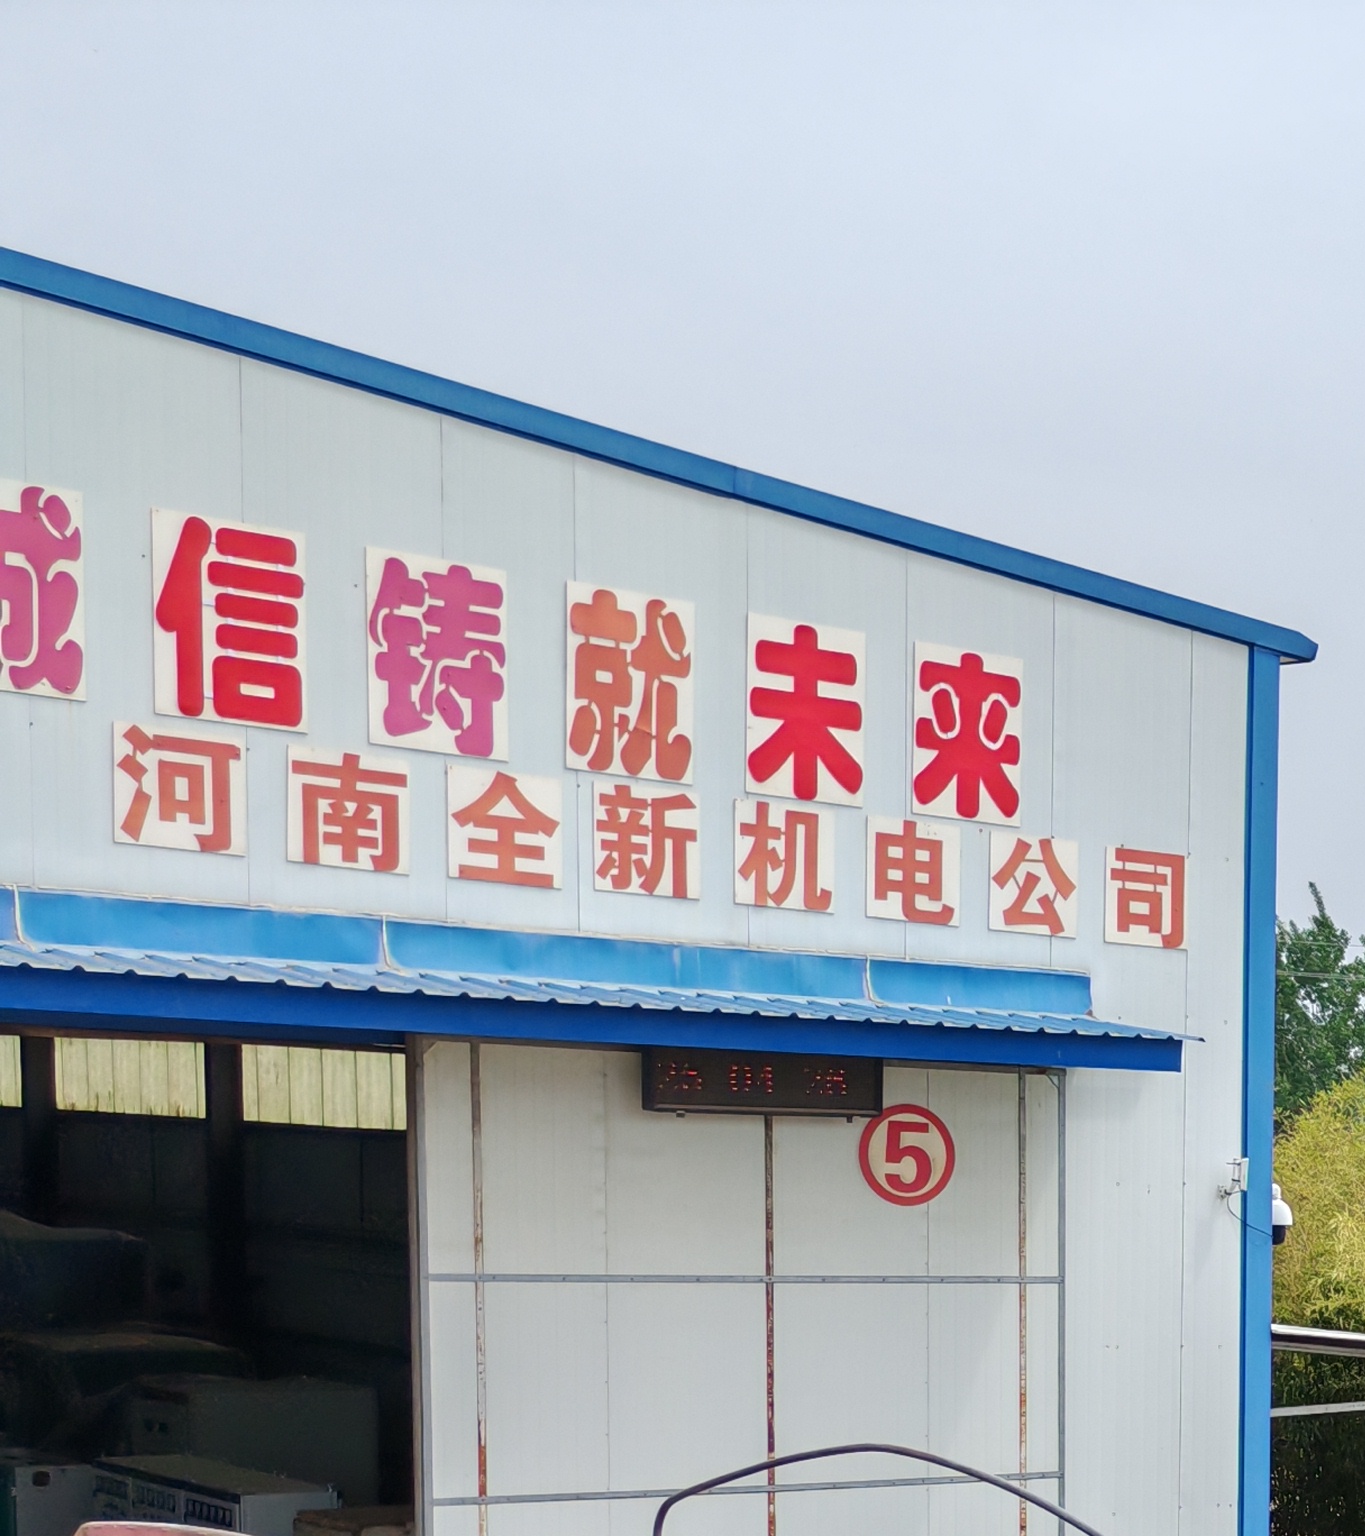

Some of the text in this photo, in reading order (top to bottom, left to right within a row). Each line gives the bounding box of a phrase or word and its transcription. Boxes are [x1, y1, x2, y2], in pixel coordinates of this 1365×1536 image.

[119, 724, 1187, 950] 河南全新机电公司
